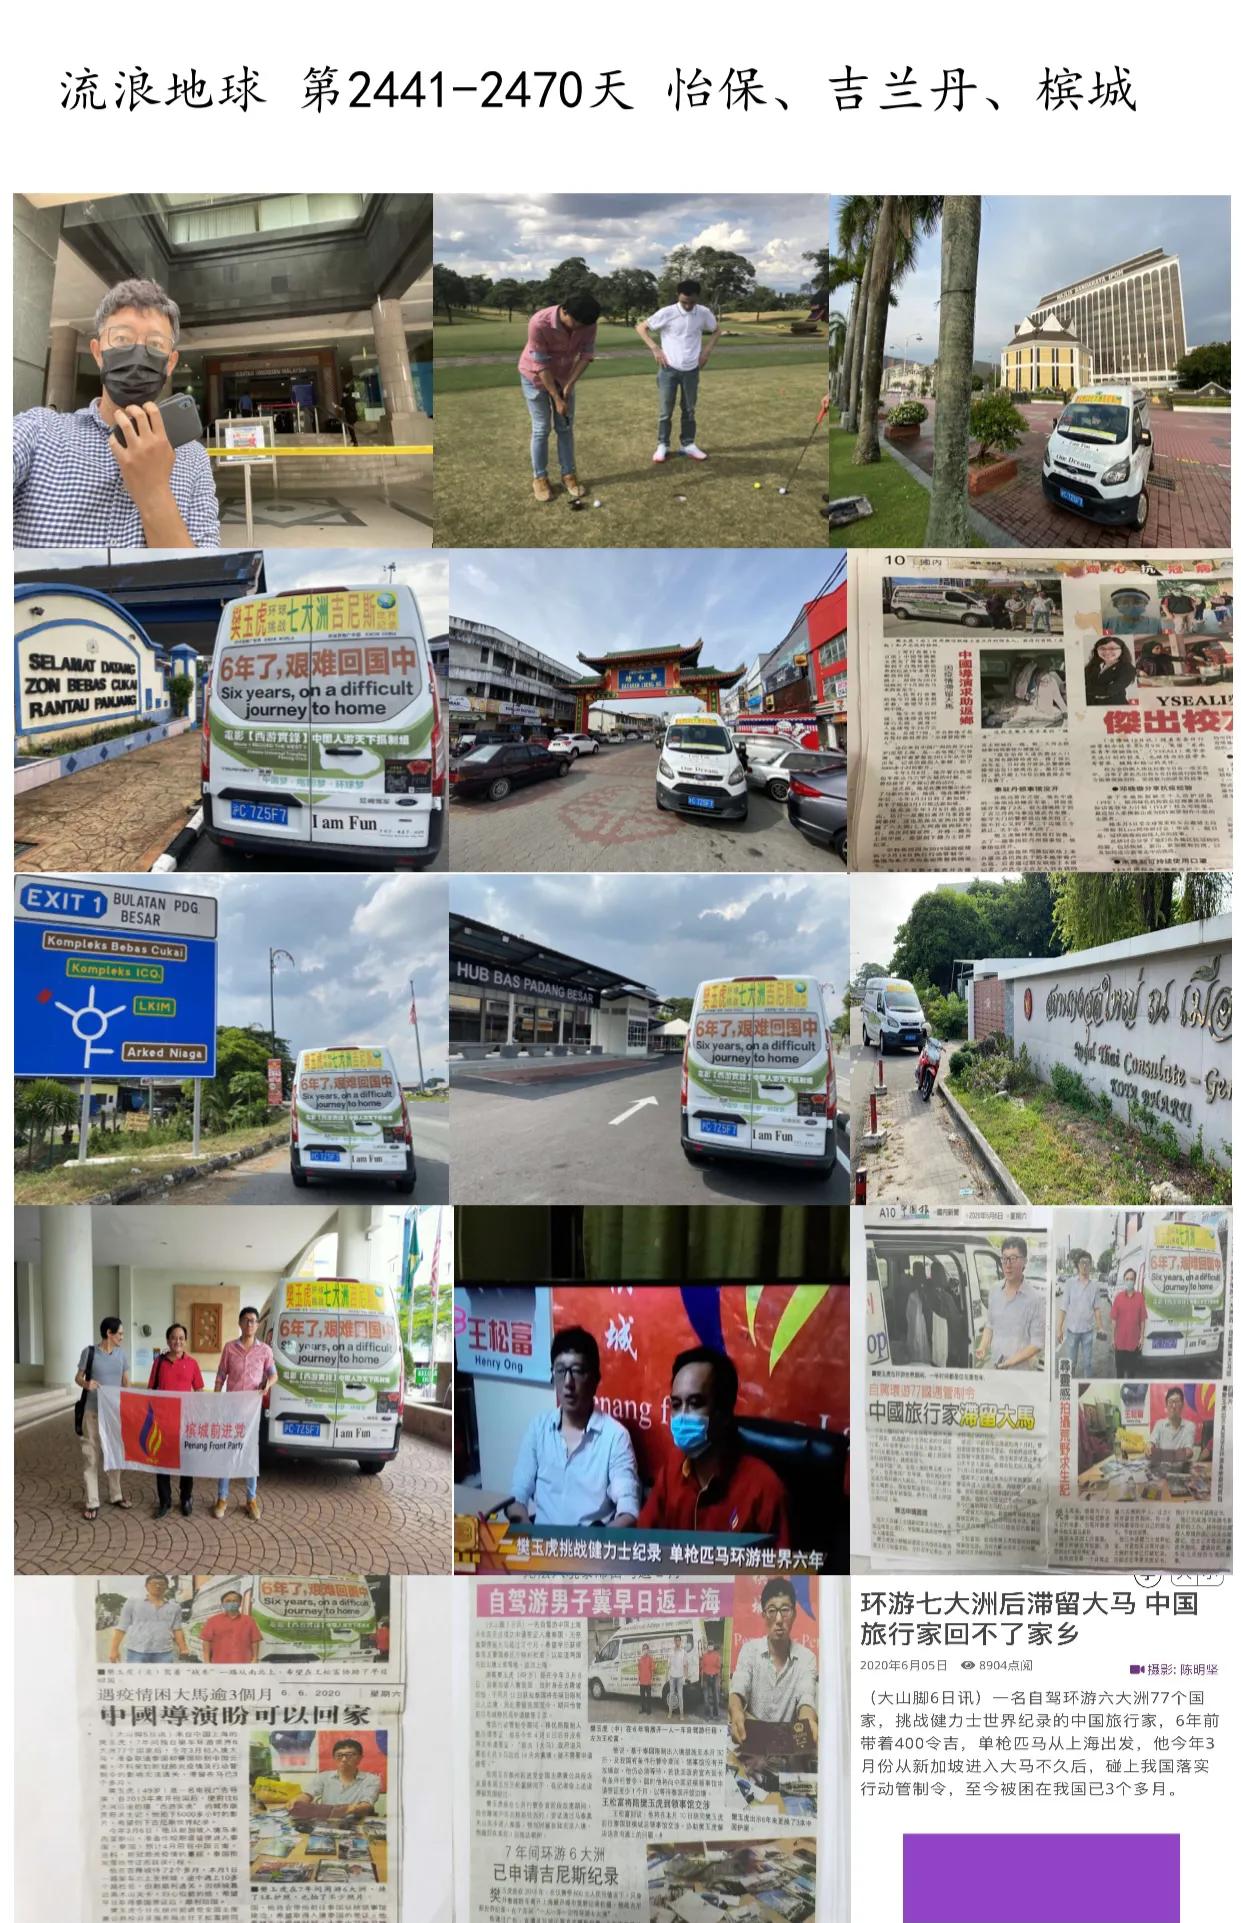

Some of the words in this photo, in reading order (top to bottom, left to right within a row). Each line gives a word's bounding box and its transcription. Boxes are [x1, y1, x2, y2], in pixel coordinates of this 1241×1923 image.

[884, 556, 905, 565] 10
[29, 653, 96, 673] SELAMAT
[101, 661, 136, 675] DATANG
[25, 678, 60, 694] ZON
[67, 678, 107, 693] BEBAS
[111, 679, 138, 691] CUKAI
[221, 686, 242, 700] Six
[247, 686, 295, 701] years,
[299, 685, 321, 697] on
[325, 685, 337, 696] a
[341, 680, 414, 697] difficult
[29, 698, 89, 719] RANTAU
[94, 695, 136, 710] PANJANG
[245, 703, 307, 720] journey
[312, 702, 330, 715] to
[335, 701, 387, 715] home
[251, 804, 287, 823] 7Z5F7
[313, 814, 318, 828] I
[322, 819, 344, 830] am
[350, 815, 377, 831] Fun
[27, 889, 85, 911] EXIT
[94, 897, 101, 913] 1
[113, 892, 166, 910] BULATAN
[121, 910, 161, 927] BESAR
[47, 936, 108, 951] Kompleks
[111, 942, 147, 954] Bebas
[151, 945, 183, 958] Cukai
[72, 963, 131, 976] Kompleks
[457, 961, 490, 982] HUB
[493, 970, 521, 989] BAS
[523, 978, 565, 998] PADANG
[567, 988, 594, 1004] BESAR
[139, 1001, 171, 1012] LKIM
[127, 1047, 163, 1058] Arked
[169, 1047, 202, 1059] Niaga
[696, 1040, 710, 1050] Six
[712, 1042, 744, 1053] years,
[745, 1042, 760, 1051] on
[762, 1042, 769, 1050] a
[771, 1040, 816, 1051] difficult
[711, 1053, 751, 1065] journey
[752, 1053, 766, 1063] to
[767, 1053, 800, 1064] home
[1098, 1043, 1121, 1068] Thai
[1124, 1052, 1187, 1087] Consulate
[360, 1090, 393, 1099] difficult
[1110, 1078, 1138, 1099] KOTA
[316, 1101, 347, 1110] journey
[753, 1129, 757, 1140] I
[758, 1132, 773, 1141] am
[775, 1130, 793, 1142] Fun
[880, 1207, 896, 1218] A10
[1163, 1275, 1184, 1283] years,
[1163, 1283, 1189, 1292] journey
[467, 1317, 533, 1358] 王松富
[332, 1343, 345, 1351] on
[298, 1354, 337, 1366] journey
[338, 1354, 351, 1364] to
[352, 1354, 380, 1365] home
[474, 1355, 500, 1371] Henry
[503, 1358, 524, 1374] Ong
[869, 1400, 1035, 1430] 中國旅行家滯留大馬
[340, 1430, 353, 1438] am
[184, 1441, 208, 1452] Penang
[209, 1441, 227, 1450] Front
[228, 1441, 244, 1451] Party
[517, 1536, 662, 1563] 樊玉虎挑战健力士纪录
[669, 1545, 825, 1569] 单枪匹马环游世界六年
[264, 1597, 281, 1605] Six
[283, 1598, 316, 1608] years,
[489, 1588, 721, 1615] 自驾游男子冀早日返上海
[860, 1591, 1136, 1616] 环游七大洲后滞留大马
[1145, 1591, 1198, 1616] 中国
[284, 1607, 325, 1616] journey
[337, 1607, 360, 1615] home
[860, 1621, 1079, 1646] 旅行家回不了家乡
[860, 1659, 947, 1672] 2020年6月05日
[979, 1659, 1033, 1672] 8904点阅
[1147, 1663, 1177, 1676] 摄影:
[1180, 1663, 1219, 1676] 陈明坚
[315, 1689, 341, 1697] 2020
[370, 1689, 401, 1698] 星期六
[100, 1704, 372, 1727] 中國導演盼可以回家
[860, 1713, 1220, 1729] 家，挑战健力士世界纪录的中国旅行家，6年前
[860, 1736, 1215, 1752] 带着400令吉，单枪匹马从上海出发，他今年3
[862, 1759, 1209, 1774] 月份从新加坡进入大马不久后，碰上我国落实
[860, 1782, 1175, 1797] 行动管制令，至今被困在我国已3个多月。
[493, 1863, 619, 1886] 已申请吉尼斯纪录
